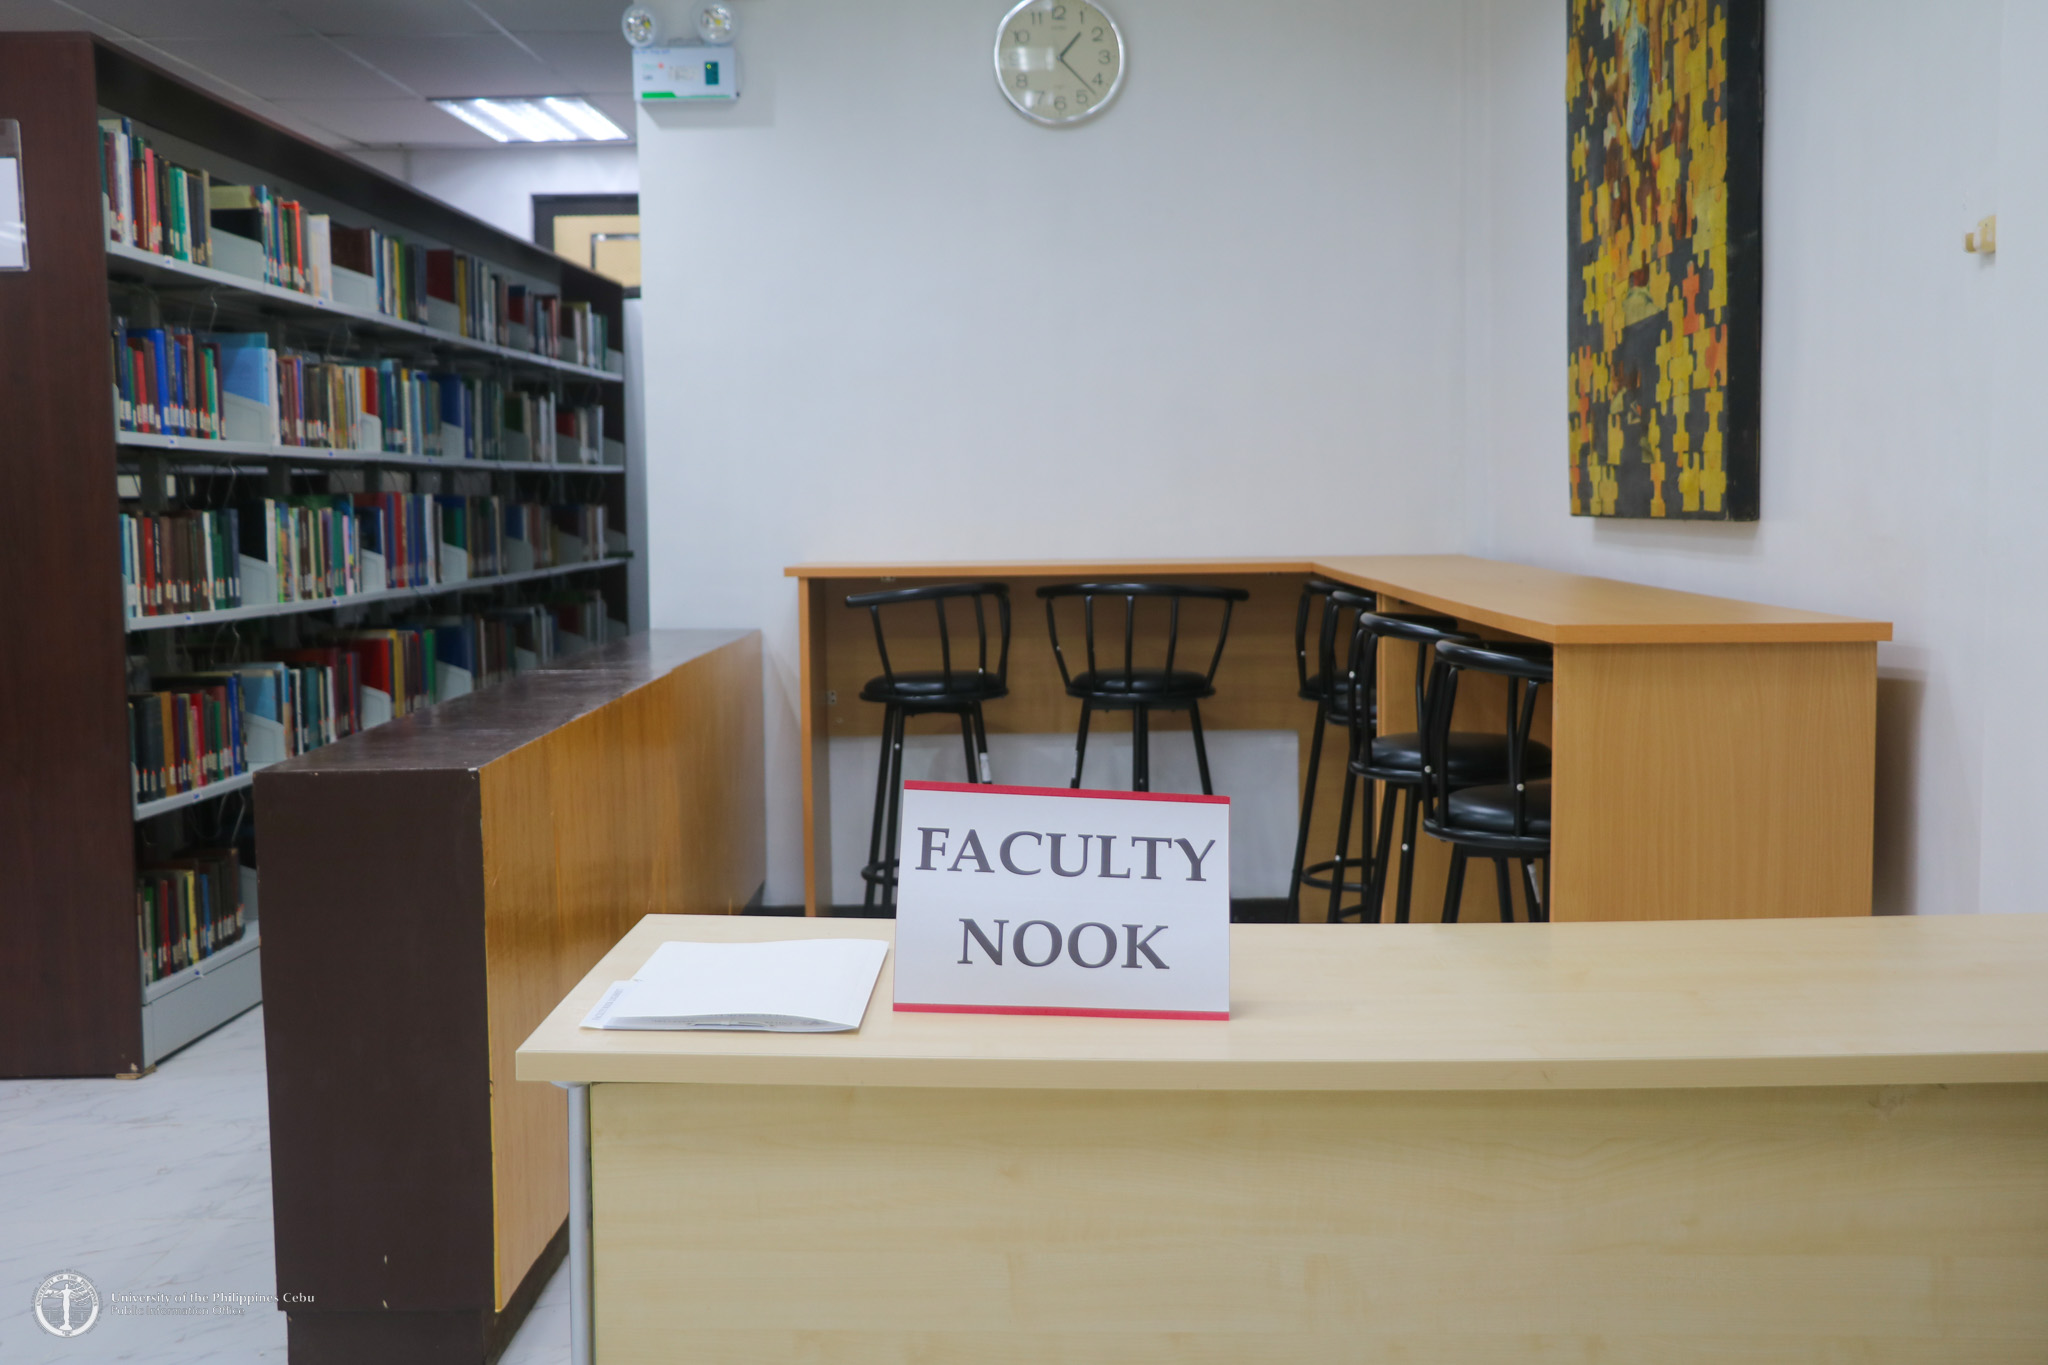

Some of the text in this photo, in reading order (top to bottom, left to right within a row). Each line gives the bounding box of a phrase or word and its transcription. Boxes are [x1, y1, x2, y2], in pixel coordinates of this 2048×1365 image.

[1031, 11, 1043, 25] 11
[1051, 5, 1067, 21] 12
[1013, 29, 1030, 45] 10
[1091, 26, 1104, 42] 2
[1098, 49, 1111, 65] 3
[1015, 73, 1028, 89] 8
[1092, 72, 1103, 86] 4
[1034, 90, 1045, 105] 7
[1053, 96, 1067, 111] 6
[1075, 89, 1088, 105] 5
[915, 826, 1216, 882] FACULTY
[957, 918, 1170, 970] NOOK
